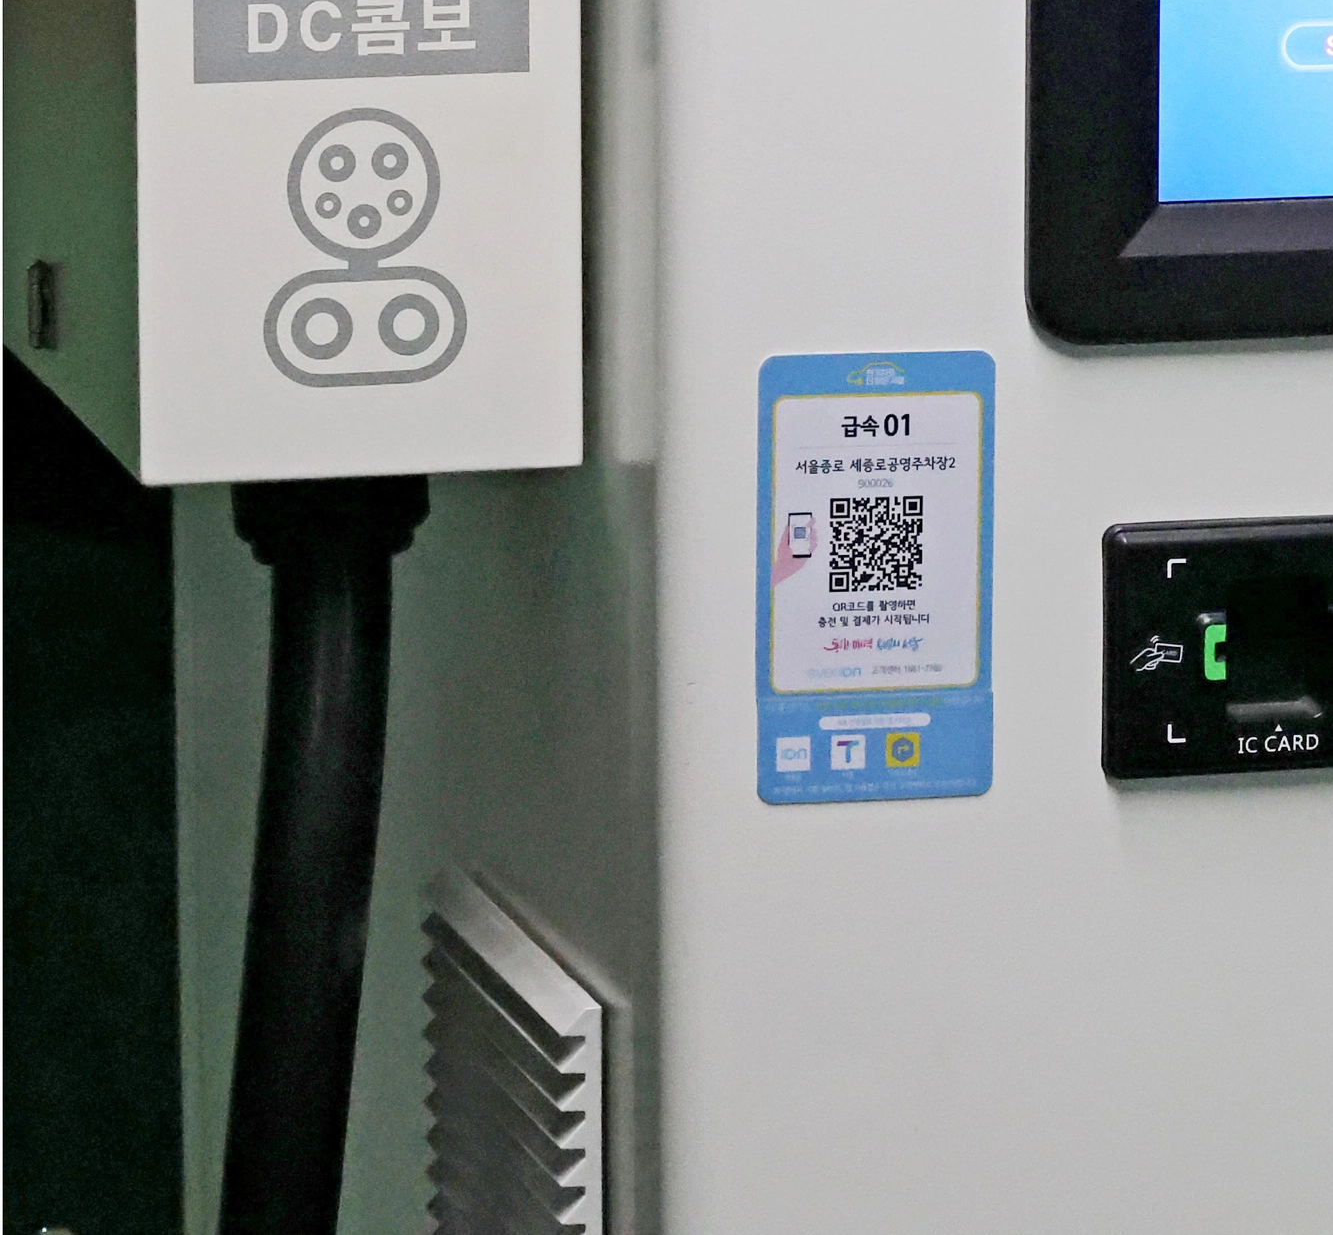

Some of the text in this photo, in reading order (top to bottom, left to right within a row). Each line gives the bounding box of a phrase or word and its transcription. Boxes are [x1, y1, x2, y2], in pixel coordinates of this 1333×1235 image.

[841, 413, 911, 438] 급속 01
[795, 456, 957, 475] 서울종로 세종로공영주차장2
[1238, 734, 1320, 754] IC CARD
